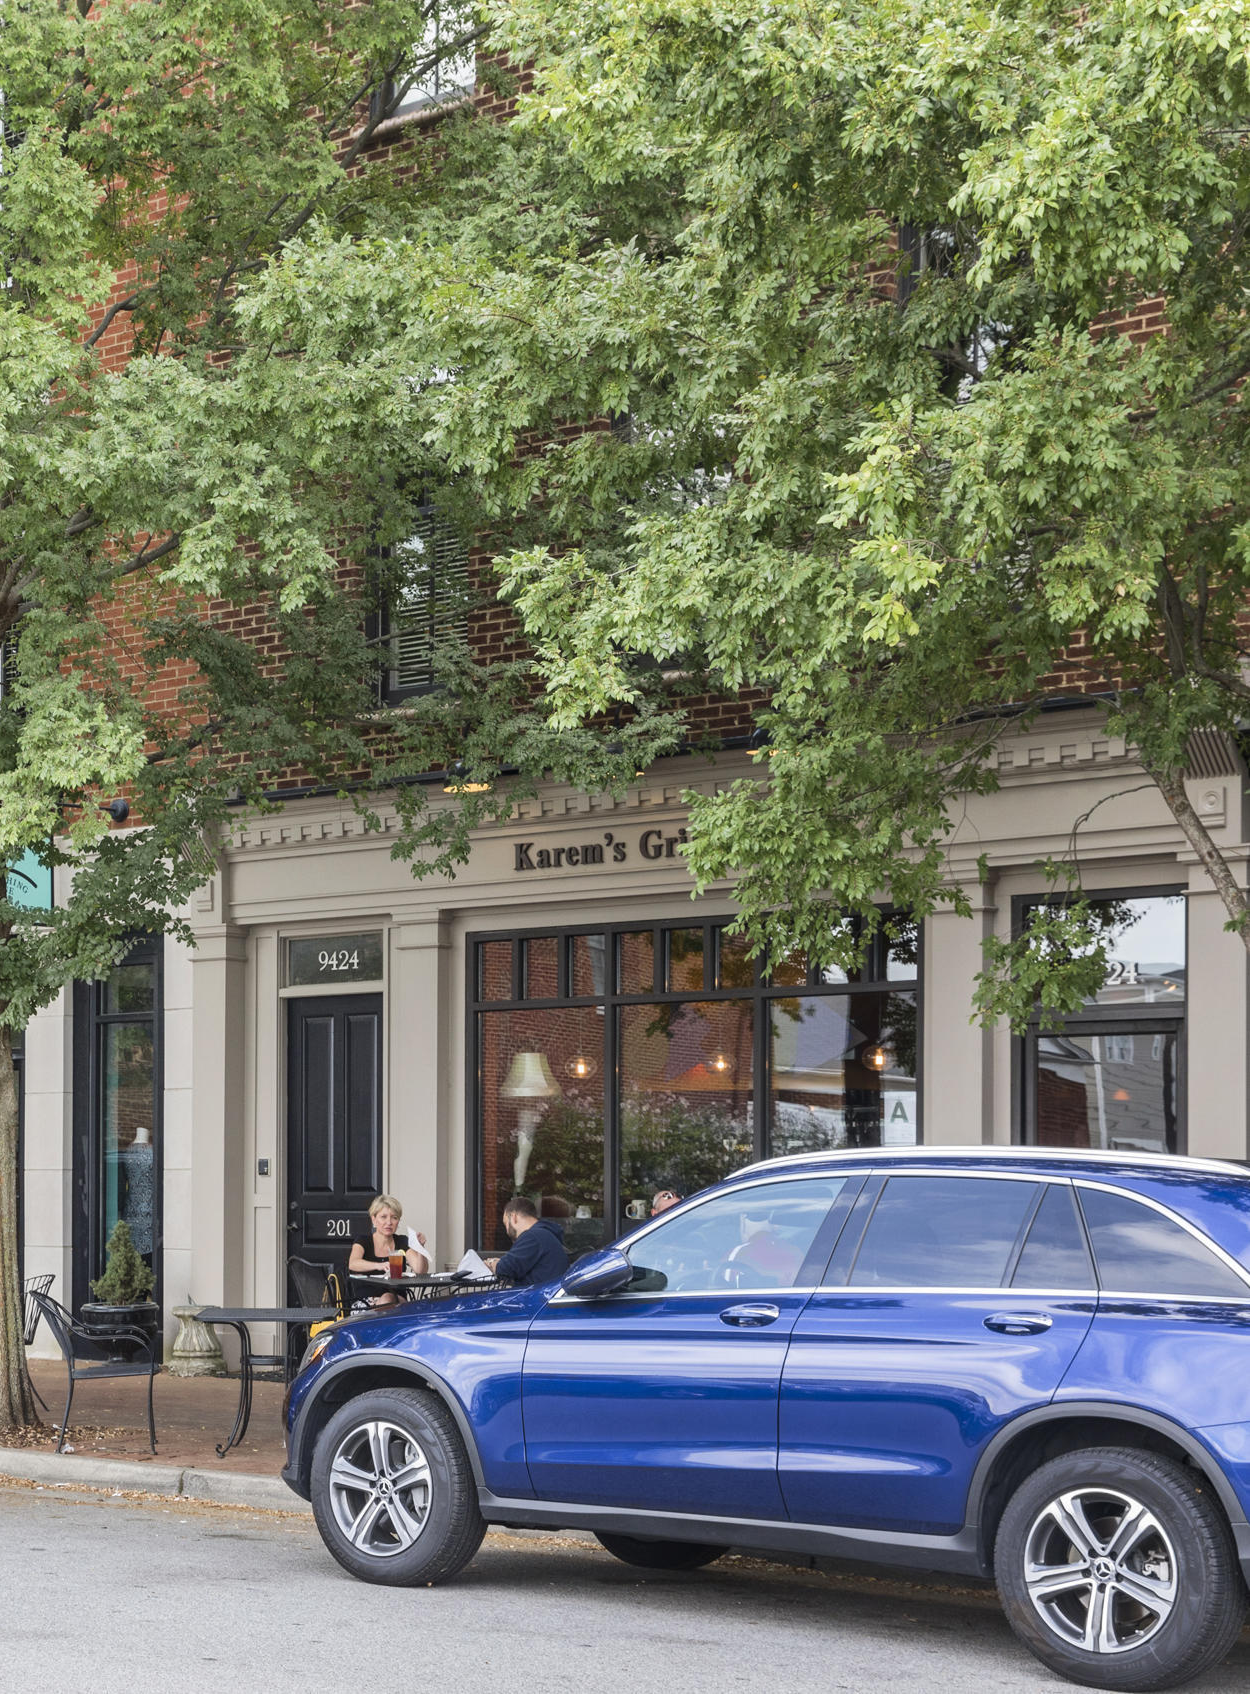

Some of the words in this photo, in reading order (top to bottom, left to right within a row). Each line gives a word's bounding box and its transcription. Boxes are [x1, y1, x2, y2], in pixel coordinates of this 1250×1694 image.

[513, 832, 627, 871] Karem's
[639, 827, 693, 860] Gri
[318, 950, 360, 971] 9424
[1105, 961, 1138, 985] 24
[890, 1100, 909, 1124] A
[326, 1219, 351, 1236] 201
